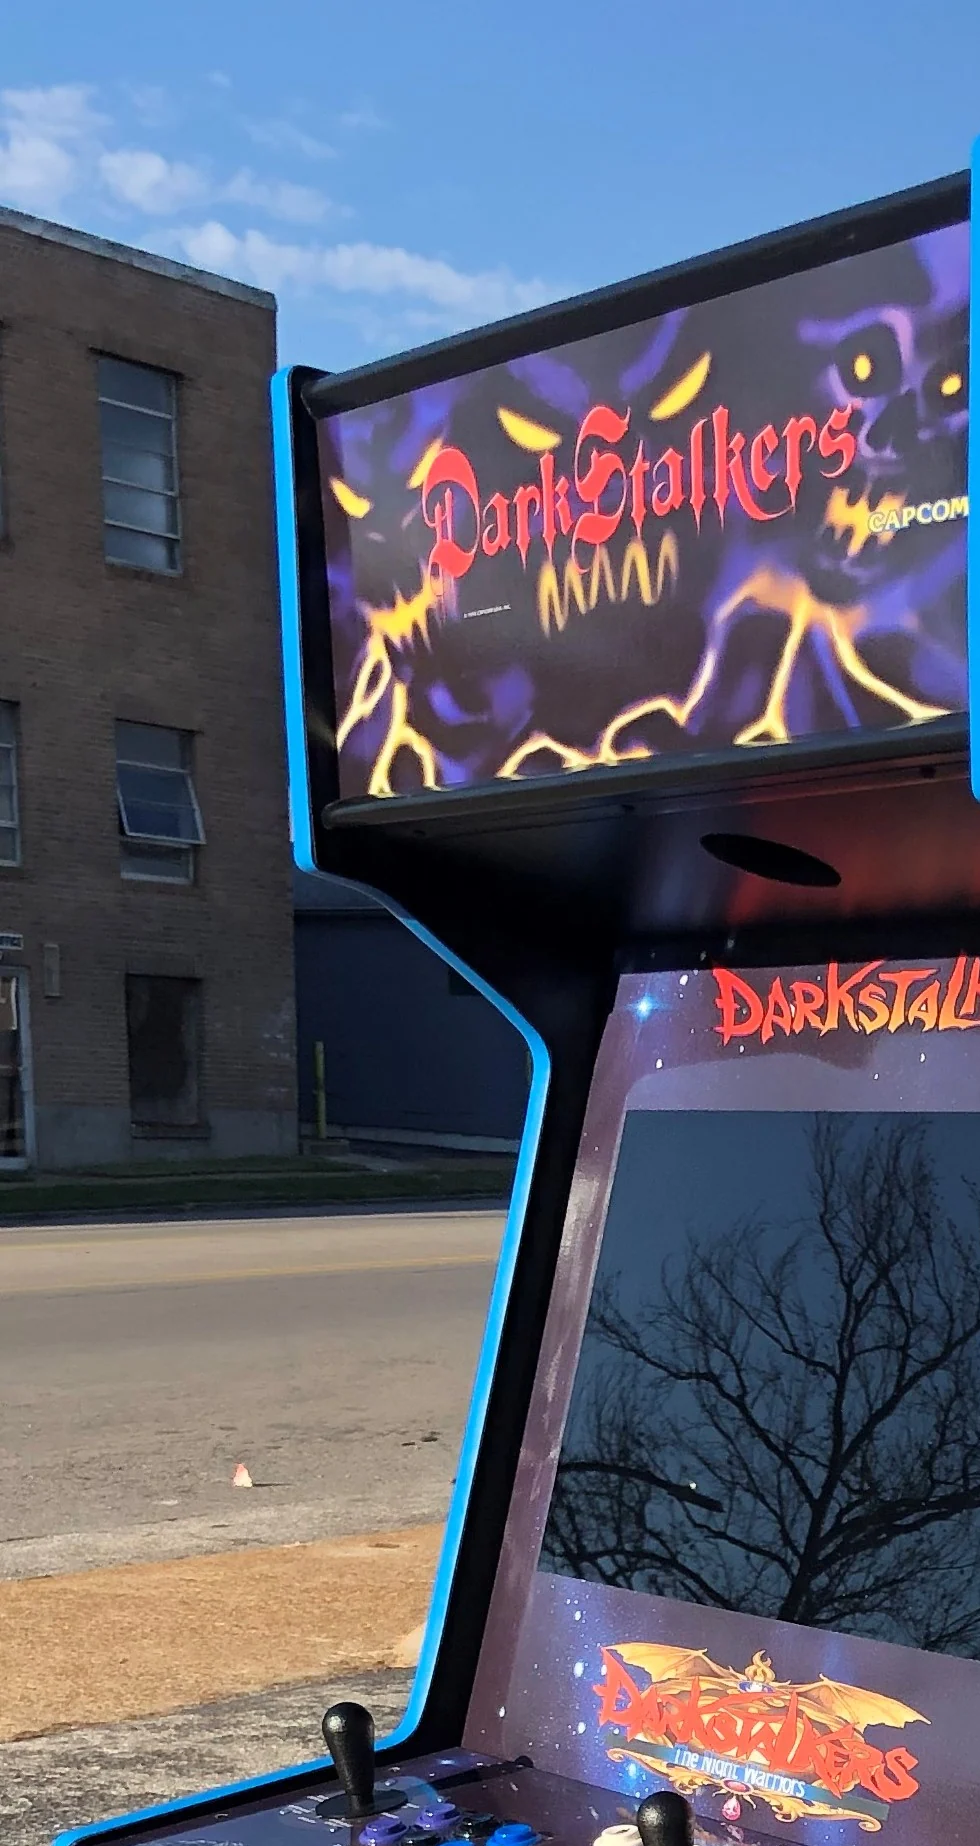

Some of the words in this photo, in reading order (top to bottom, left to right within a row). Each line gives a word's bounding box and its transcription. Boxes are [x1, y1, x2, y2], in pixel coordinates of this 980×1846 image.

[868, 496, 970, 533] CAPCOM
[593, 1646, 919, 1803] DARKSTALKERS
[744, 1764, 807, 1798] Warriors
